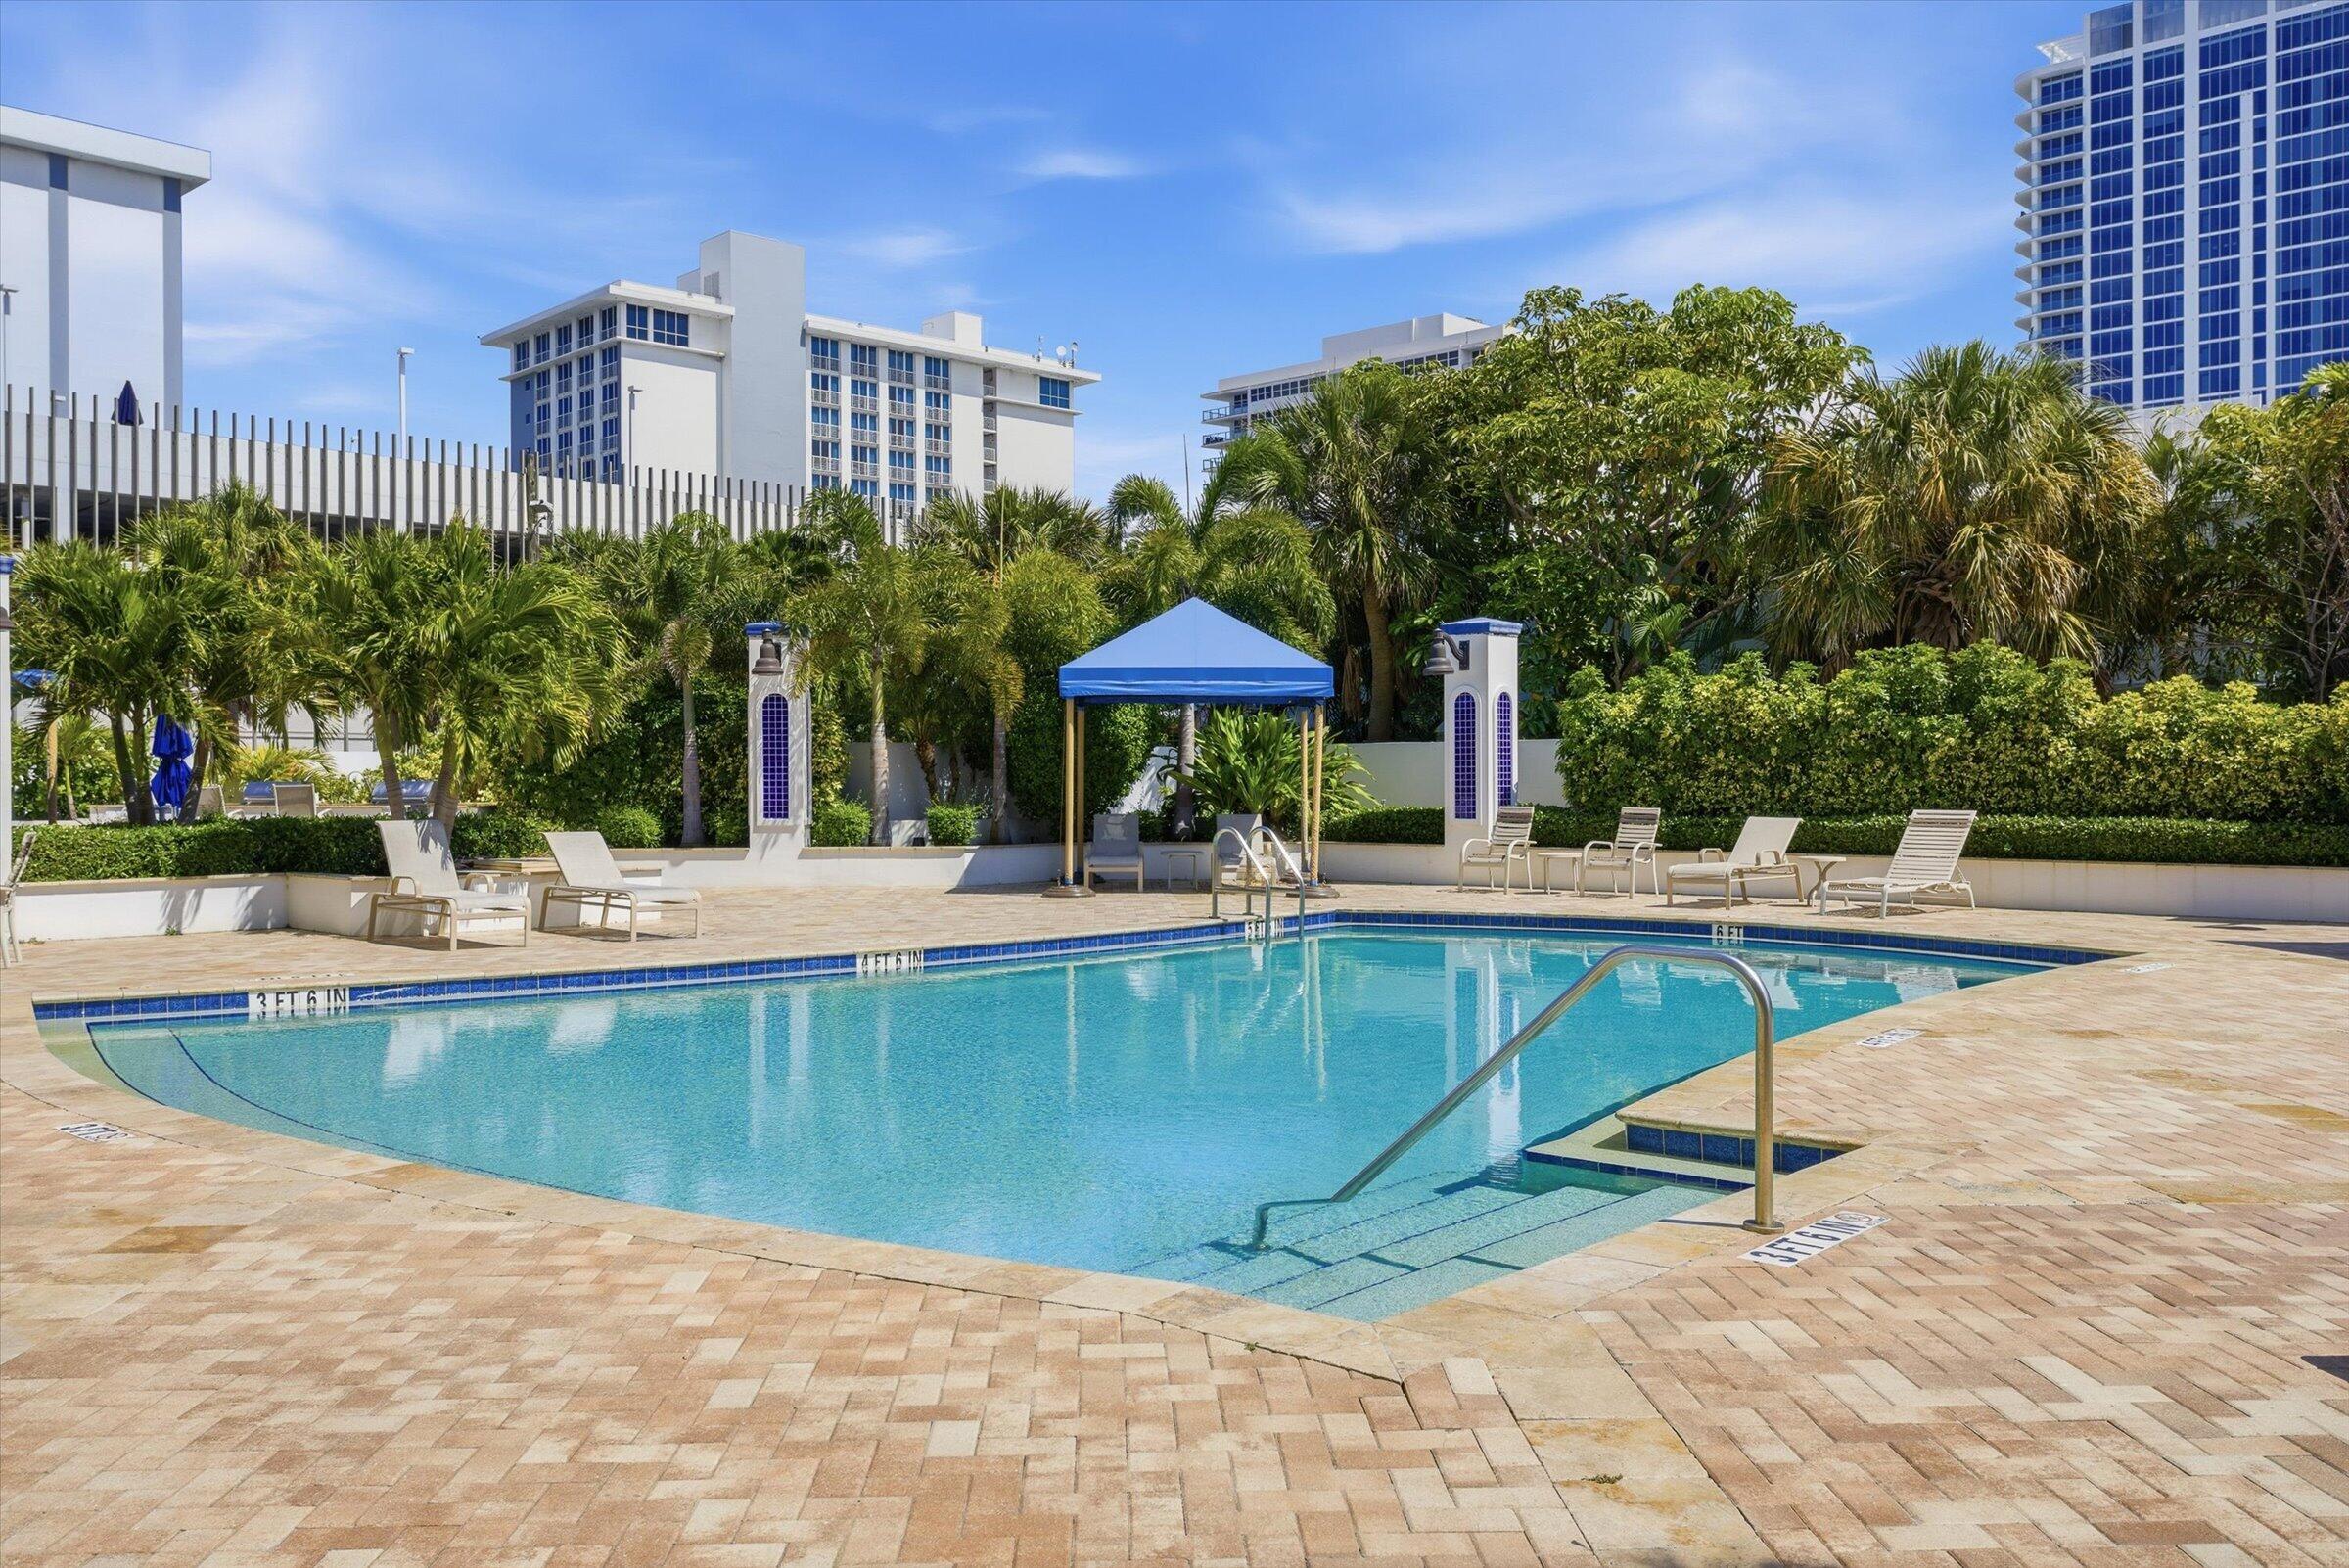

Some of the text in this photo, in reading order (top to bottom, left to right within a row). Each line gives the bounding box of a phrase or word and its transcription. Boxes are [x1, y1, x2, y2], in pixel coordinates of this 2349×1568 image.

[1717, 925, 1742, 937] 6 FT
[861, 950, 922, 968] 4 FT 6 IN
[256, 988, 346, 1008] 3 FT 6 IN
[1809, 1220, 1867, 1235] IN
[1794, 1231, 1841, 1242] 6
[1766, 1237, 1824, 1256] FT
[1750, 1251, 1798, 1263] 3
